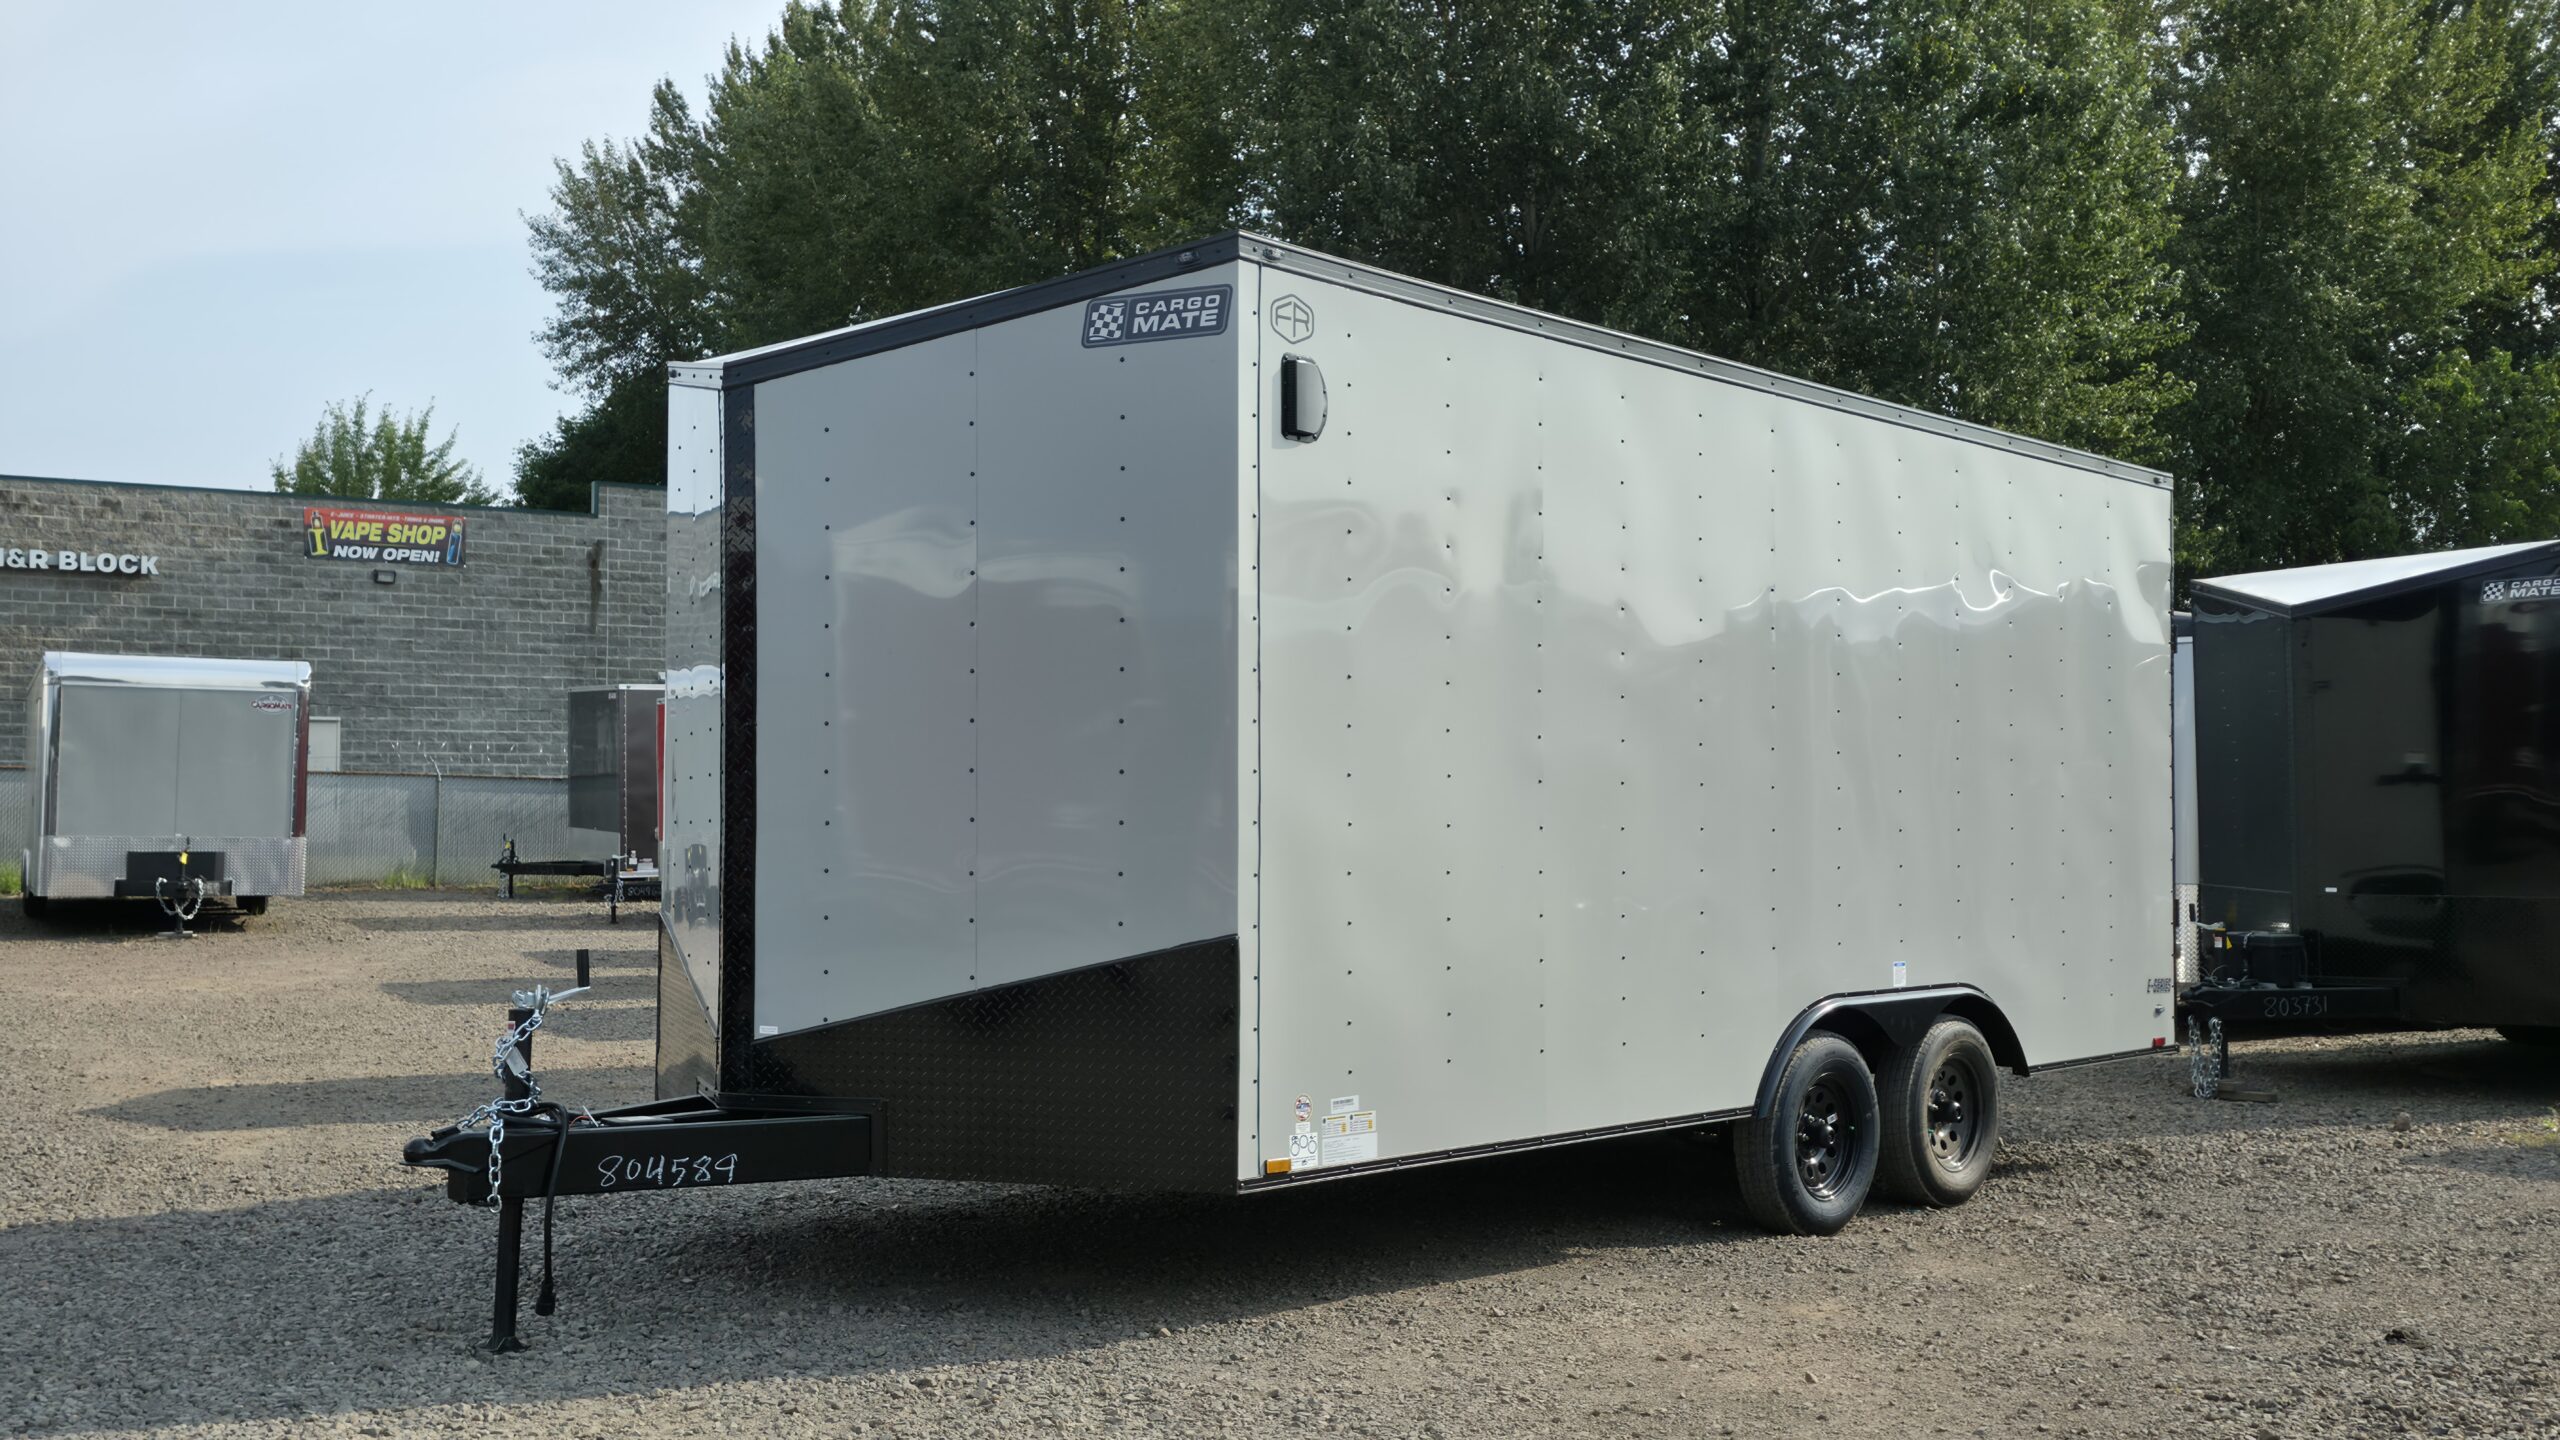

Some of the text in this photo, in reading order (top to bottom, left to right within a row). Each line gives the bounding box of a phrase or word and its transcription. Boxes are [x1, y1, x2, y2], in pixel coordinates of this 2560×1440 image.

[1135, 294, 1221, 315] CARGO
[1132, 308, 1219, 334] MATE
[330, 519, 447, 545] VAPE SHOP
[0, 547, 160, 575] &R BLOCK
[333, 545, 441, 563] NOW OPEN!
[2509, 586, 2560, 598] MATE
[2263, 995, 2328, 1018] 803731
[598, 1153, 738, 1187] 804589
